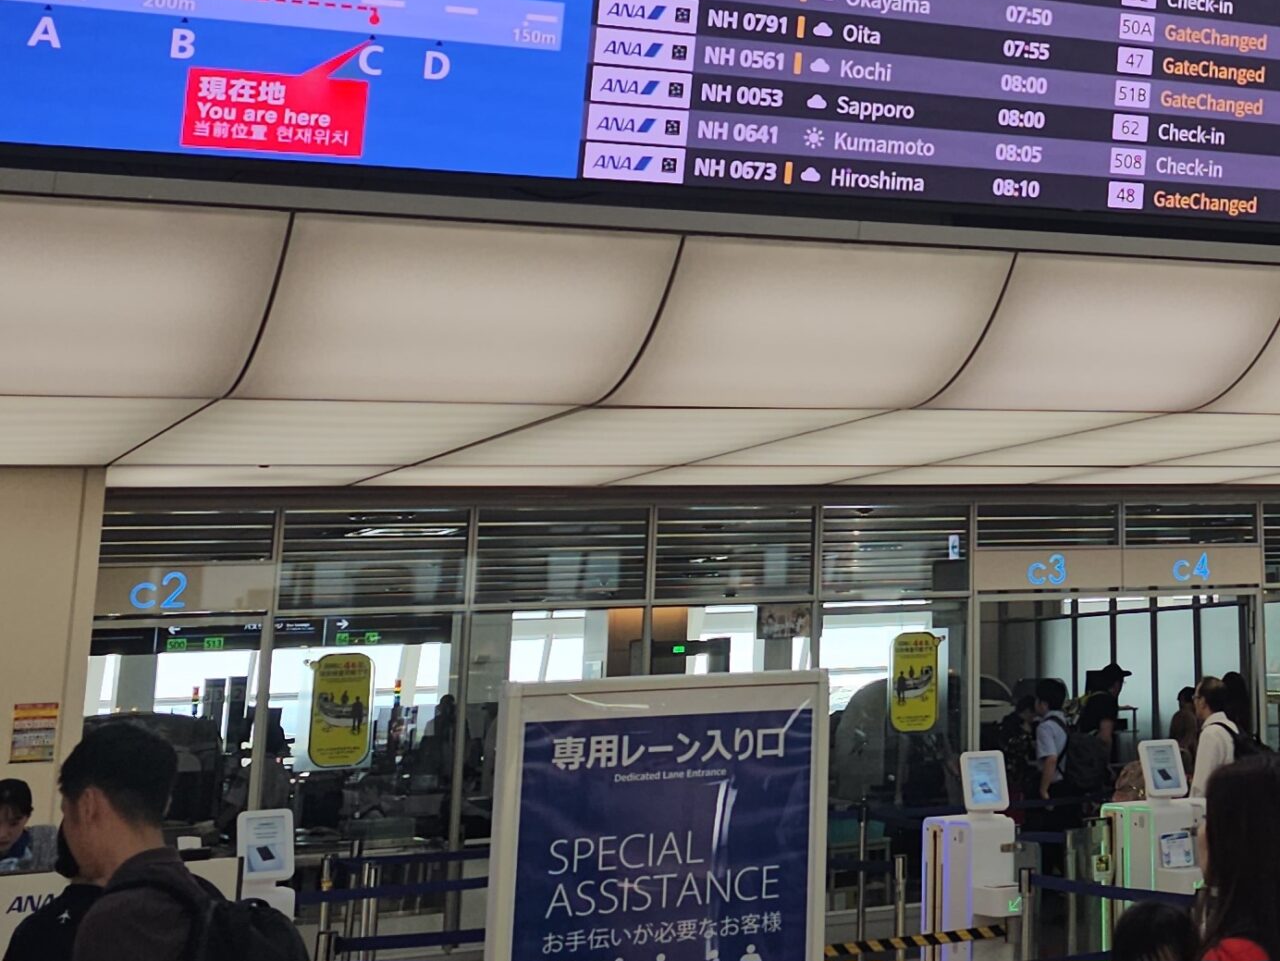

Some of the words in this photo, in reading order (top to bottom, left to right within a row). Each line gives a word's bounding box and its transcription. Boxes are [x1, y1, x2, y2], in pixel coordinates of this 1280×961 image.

[27, 16, 60, 48] A
[170, 28, 194, 58] B
[358, 44, 383, 75] C
[423, 50, 450, 79] D
[514, 28, 555, 43] 150m
[197, 76, 285, 104] 現在地
[603, 38, 646, 55] ANA
[704, 46, 735, 65] NH
[740, 49, 784, 70] 0561
[840, 59, 891, 81] Kochi
[1001, 74, 1047, 94] 08:00
[1118, 85, 1146, 101] 51B
[1160, 90, 1262, 117] GateChanged
[197, 101, 236, 120] You
[242, 108, 277, 123] are
[284, 108, 330, 126] here
[193, 121, 267, 140] 当前位置
[276, 126, 348, 145] 현재위치
[593, 152, 636, 168] ANA
[694, 157, 725, 177] NH
[729, 160, 776, 180] 0673
[831, 168, 924, 191] Hiroshima
[992, 178, 1039, 197] 08:10
[1116, 188, 1134, 202] 48
[1153, 190, 1256, 215] GateChanged
[1028, 554, 1066, 585] c3
[1172, 552, 1210, 582] c4
[129, 572, 188, 609] c2
[552, 728, 785, 770] 専用レーン入り口
[614, 771, 660, 783] Dedicated
[662, 770, 684, 780] Lane
[686, 767, 727, 778] Entrance
[548, 831, 705, 875] SPECIAL
[545, 865, 780, 919] ASSISTANCE
[542, 912, 782, 954] お手伝いが必要なお客様
